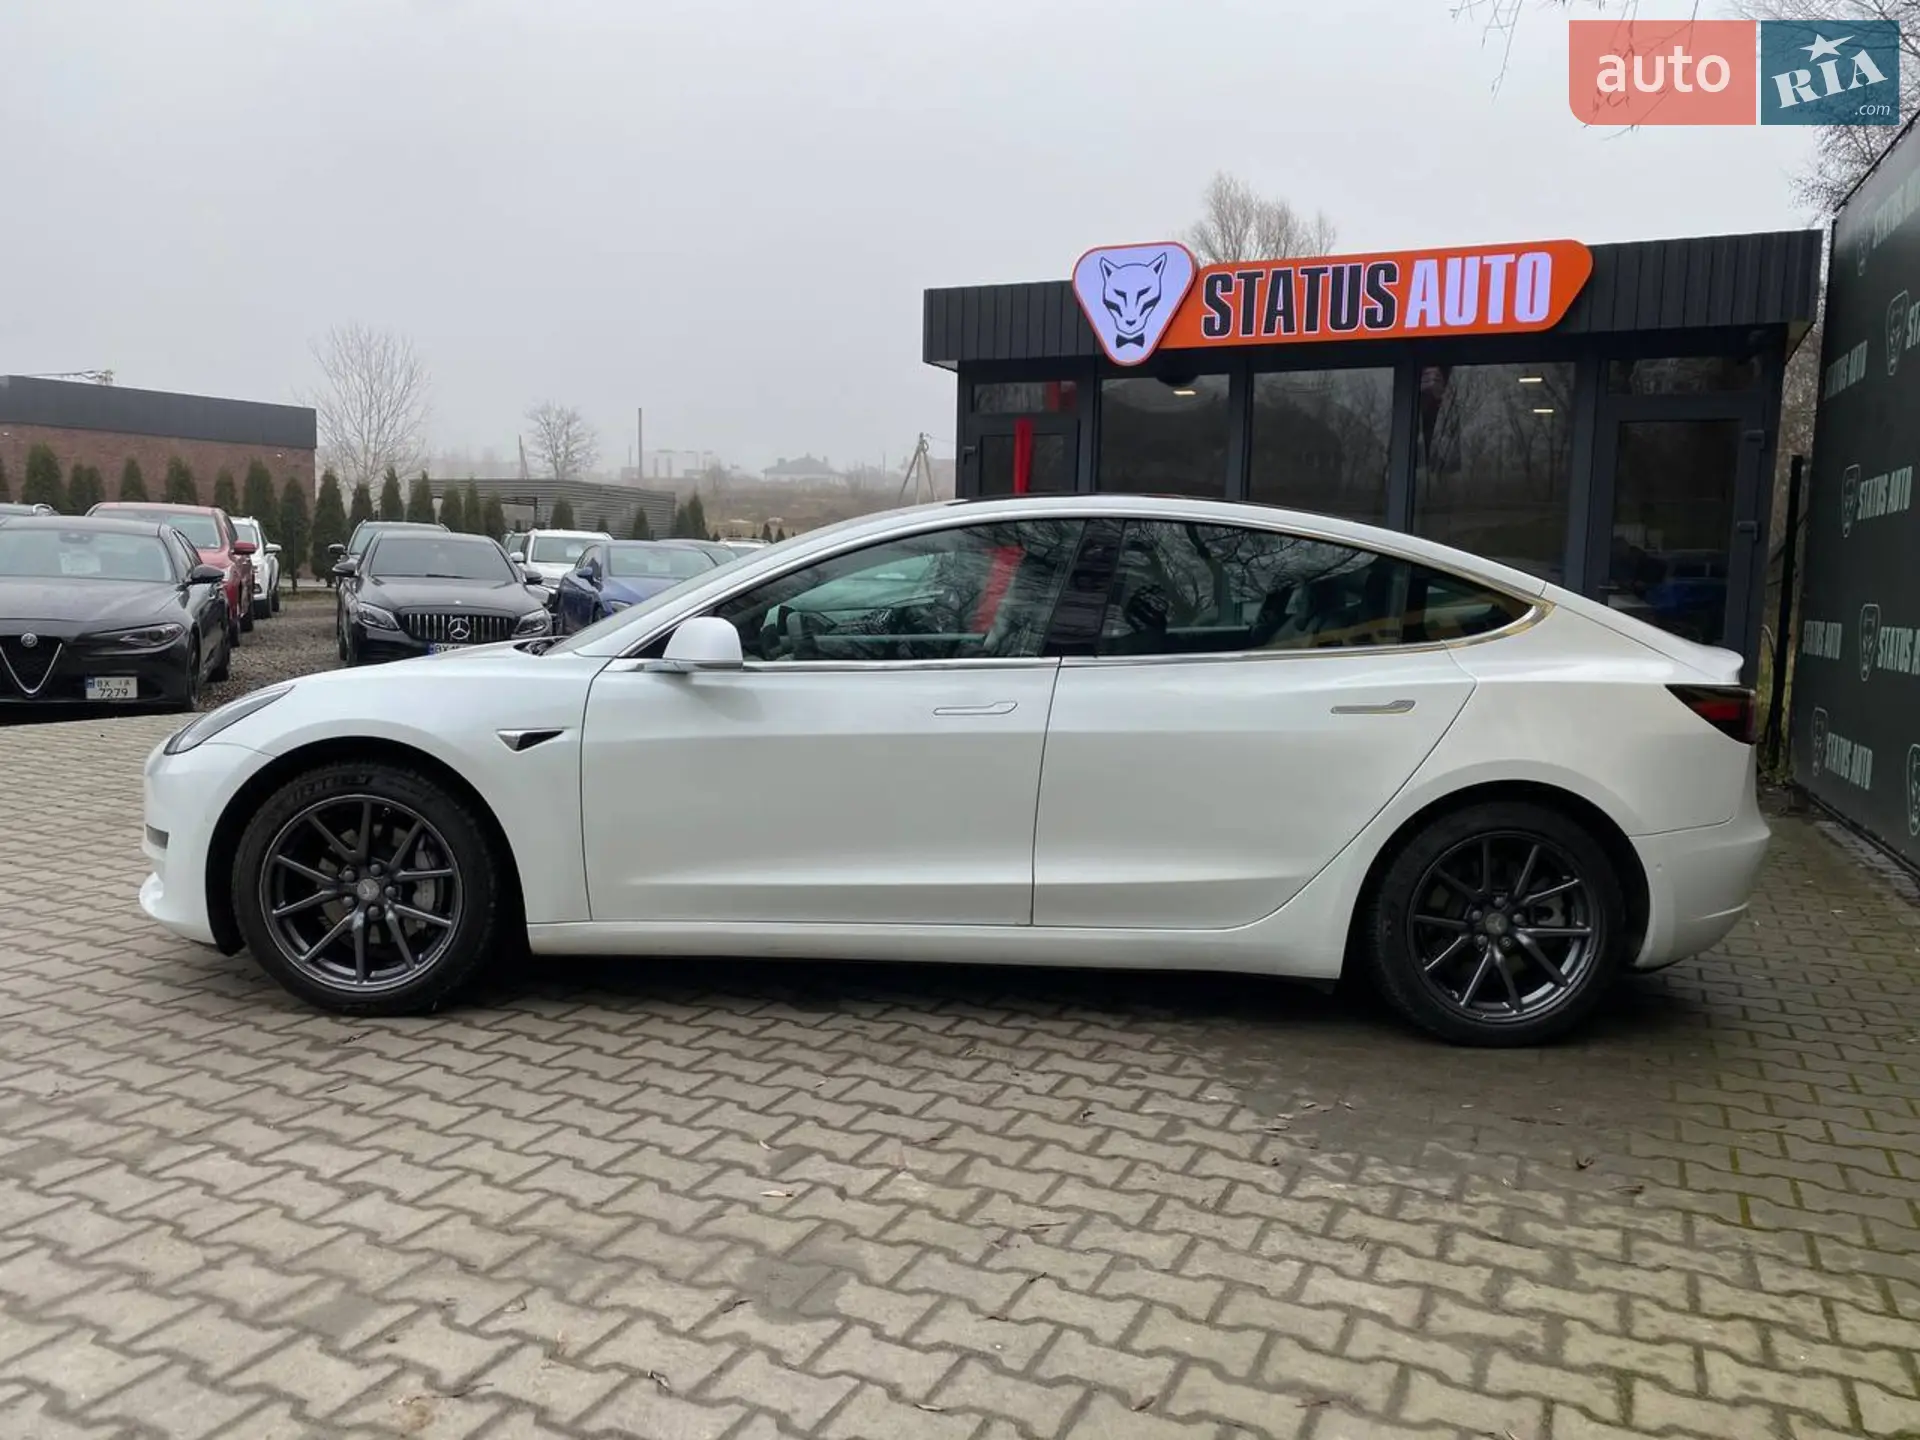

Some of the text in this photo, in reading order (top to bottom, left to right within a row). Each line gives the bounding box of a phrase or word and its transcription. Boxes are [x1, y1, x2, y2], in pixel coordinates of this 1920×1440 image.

[1200, 251, 1553, 339] STATUS AUTO
[1858, 473, 1888, 520] STATUS
[1877, 626, 1913, 672] STATUS
[99, 688, 128, 697] 7279
[1825, 731, 1852, 779] STATUS
